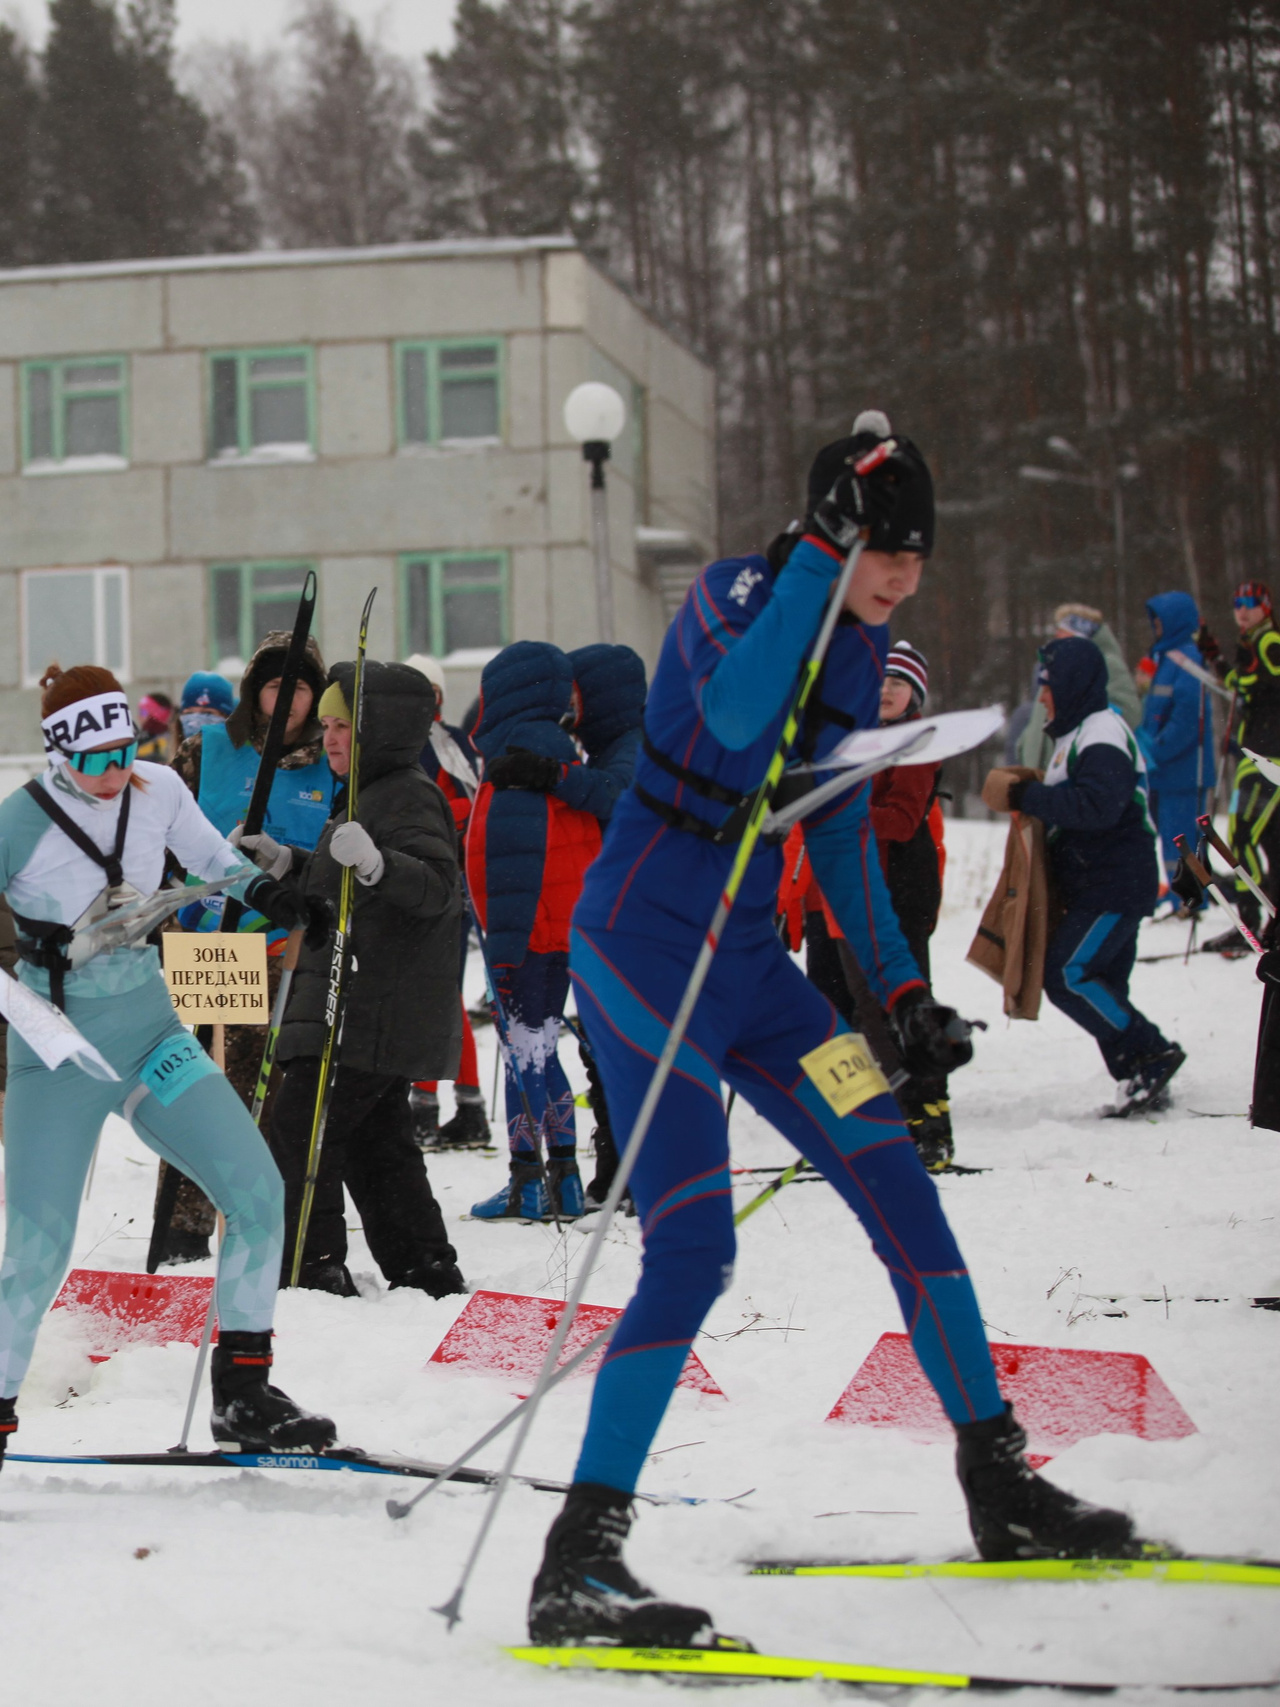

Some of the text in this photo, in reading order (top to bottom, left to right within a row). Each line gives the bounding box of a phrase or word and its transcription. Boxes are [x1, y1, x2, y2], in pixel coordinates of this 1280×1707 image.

[193, 947, 238, 963] ЗОНА
[171, 970, 261, 987] ПЕРЕДАЧИ
[324, 929, 344, 1027] FISCHER
[170, 993, 263, 1009] ЭСТАФЕТЫ
[153, 1046, 198, 1081] 103.2
